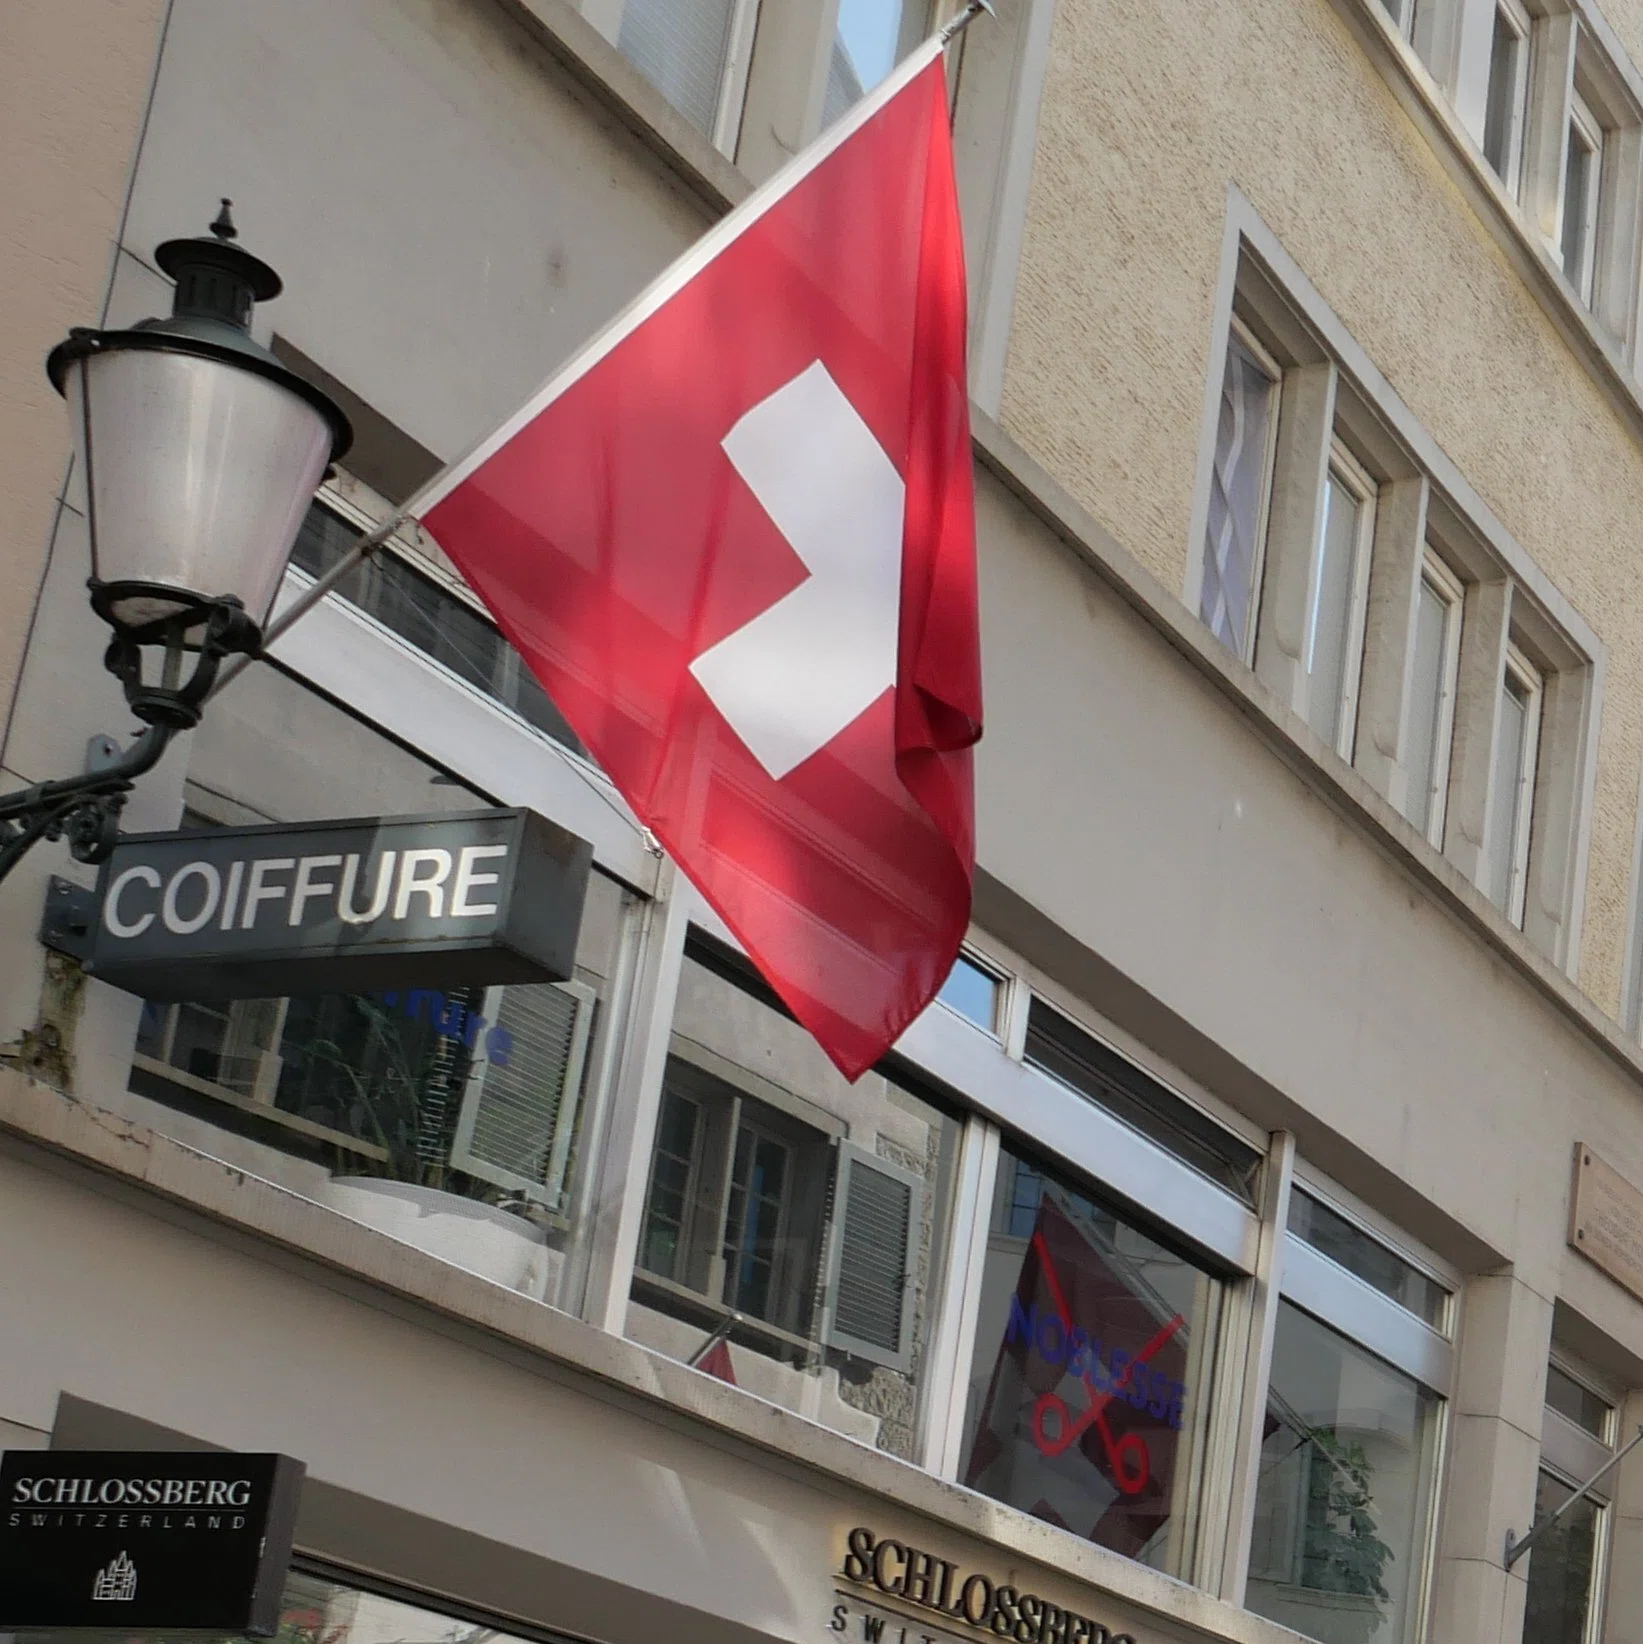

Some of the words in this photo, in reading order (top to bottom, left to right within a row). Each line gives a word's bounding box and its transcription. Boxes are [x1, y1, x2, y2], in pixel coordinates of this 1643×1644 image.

[104, 844, 508, 939] COIFFURE
[1009, 1292, 1186, 1432] NOBLESSE
[9, 1513, 246, 1529] SWITZERLAND
[12, 1478, 250, 1505] SCHLOSSBERG
